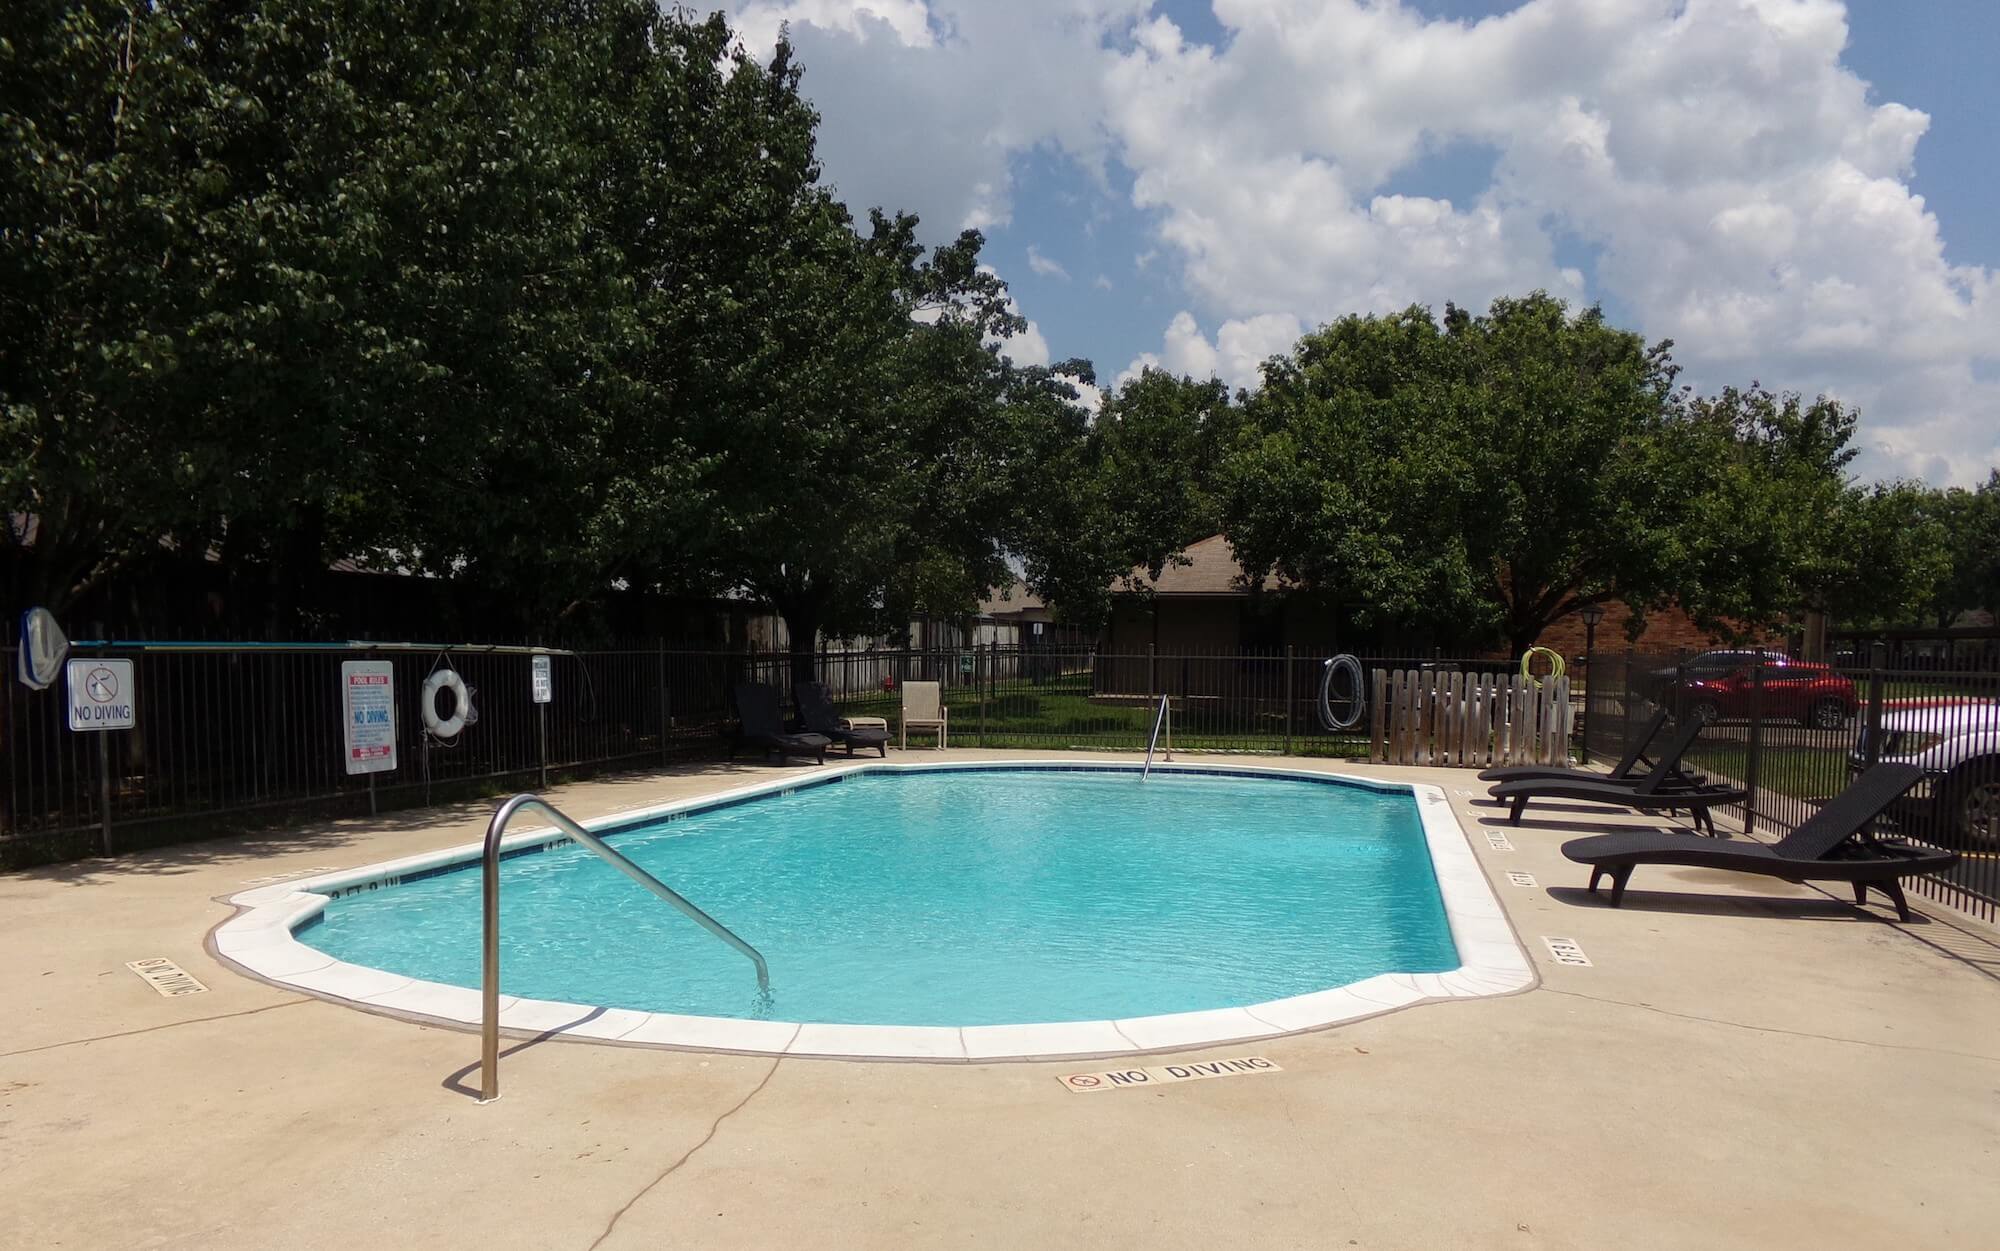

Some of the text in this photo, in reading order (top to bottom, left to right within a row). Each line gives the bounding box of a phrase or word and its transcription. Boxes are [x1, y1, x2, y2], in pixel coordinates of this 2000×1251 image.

[353, 676, 368, 685] POOL
[75, 704, 131, 721] NO DIVING
[354, 710, 389, 724] NO DIVING
[1105, 1056, 1272, 1085] NO DIVING
